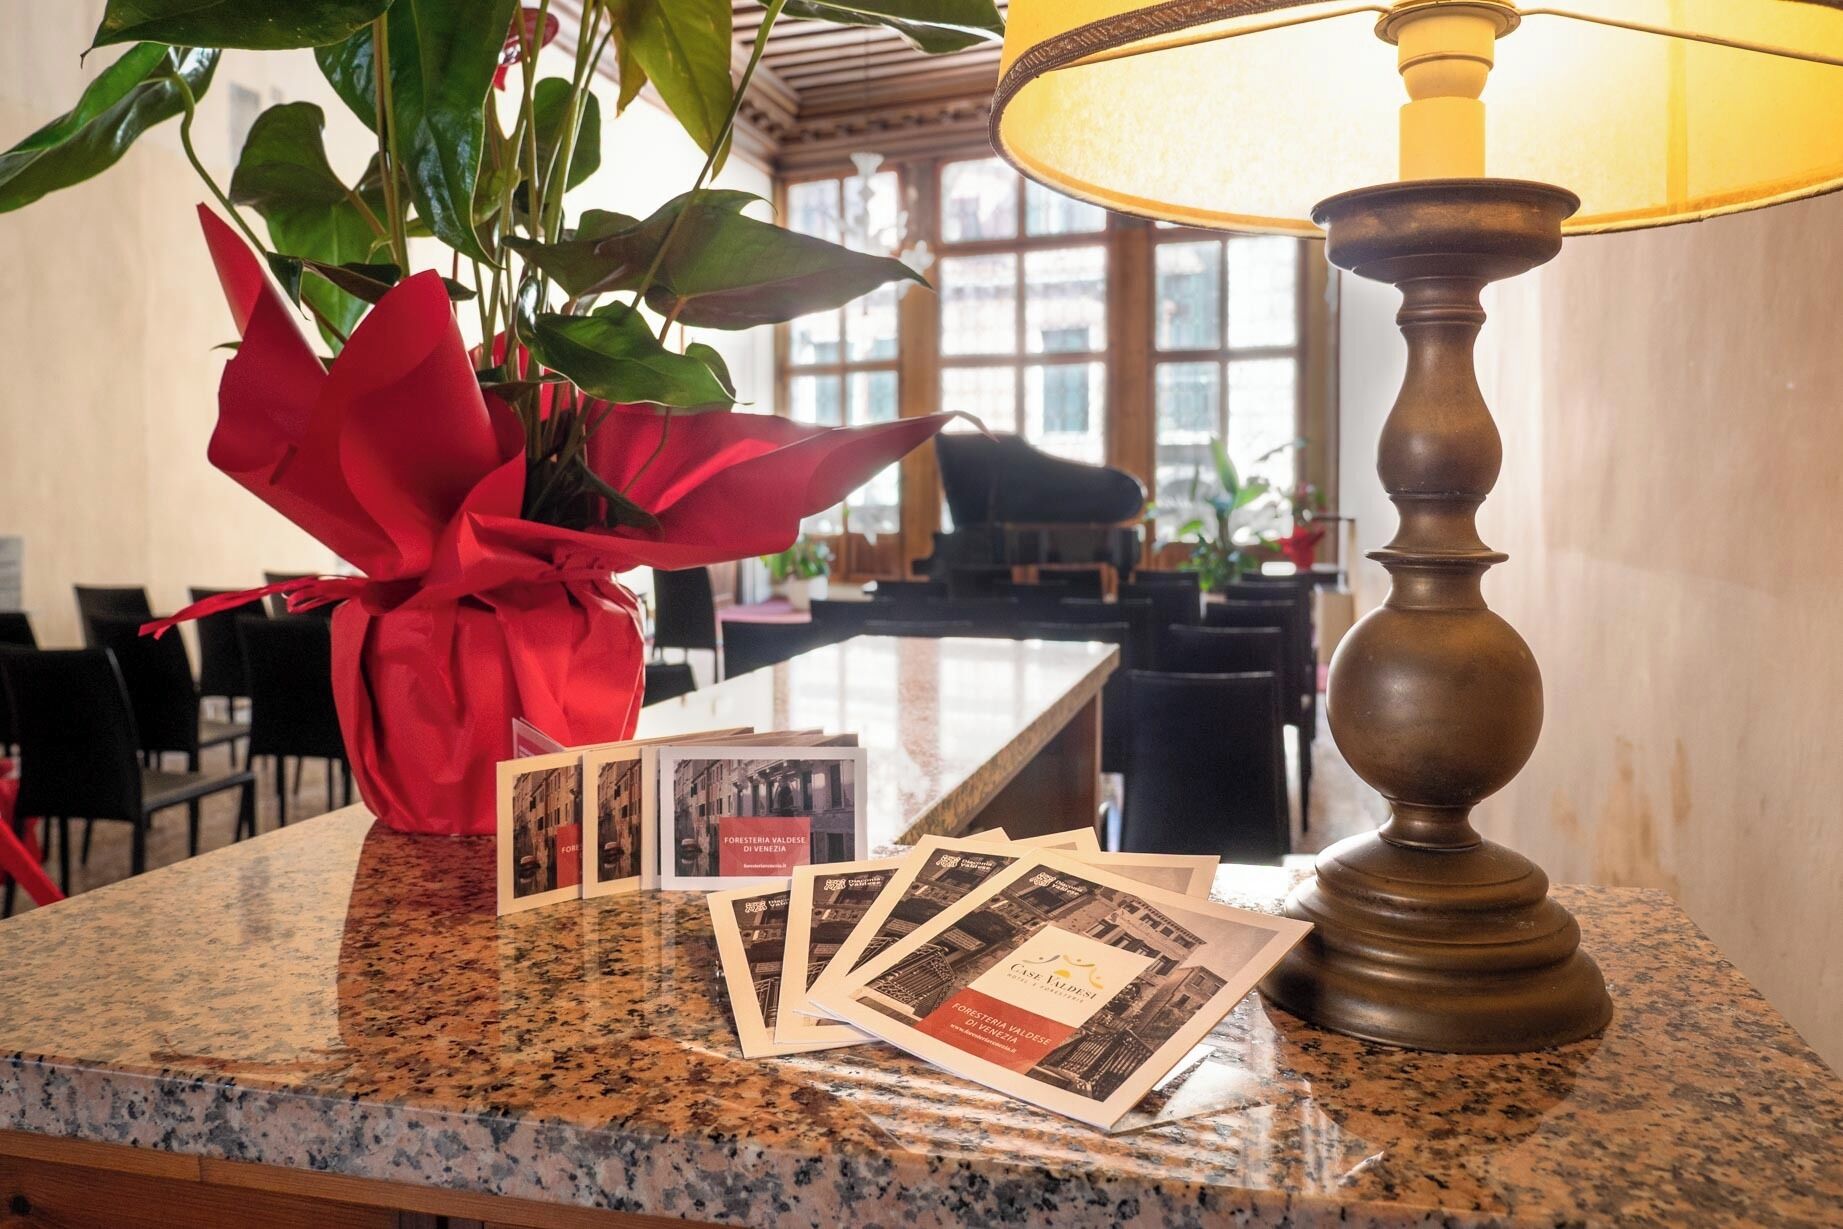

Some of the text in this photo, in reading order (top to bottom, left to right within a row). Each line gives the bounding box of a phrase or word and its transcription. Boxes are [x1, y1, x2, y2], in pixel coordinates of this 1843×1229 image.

[725, 836, 806, 844] FORESTERIA VALDESE
[743, 845, 786, 853] DI VENEZIA
[1010, 963, 1097, 1000] CASE VALDESI
[951, 1002, 1053, 1046] FORESTERIA VALDESE
[965, 1018, 1019, 1045] DI VENEZIA
